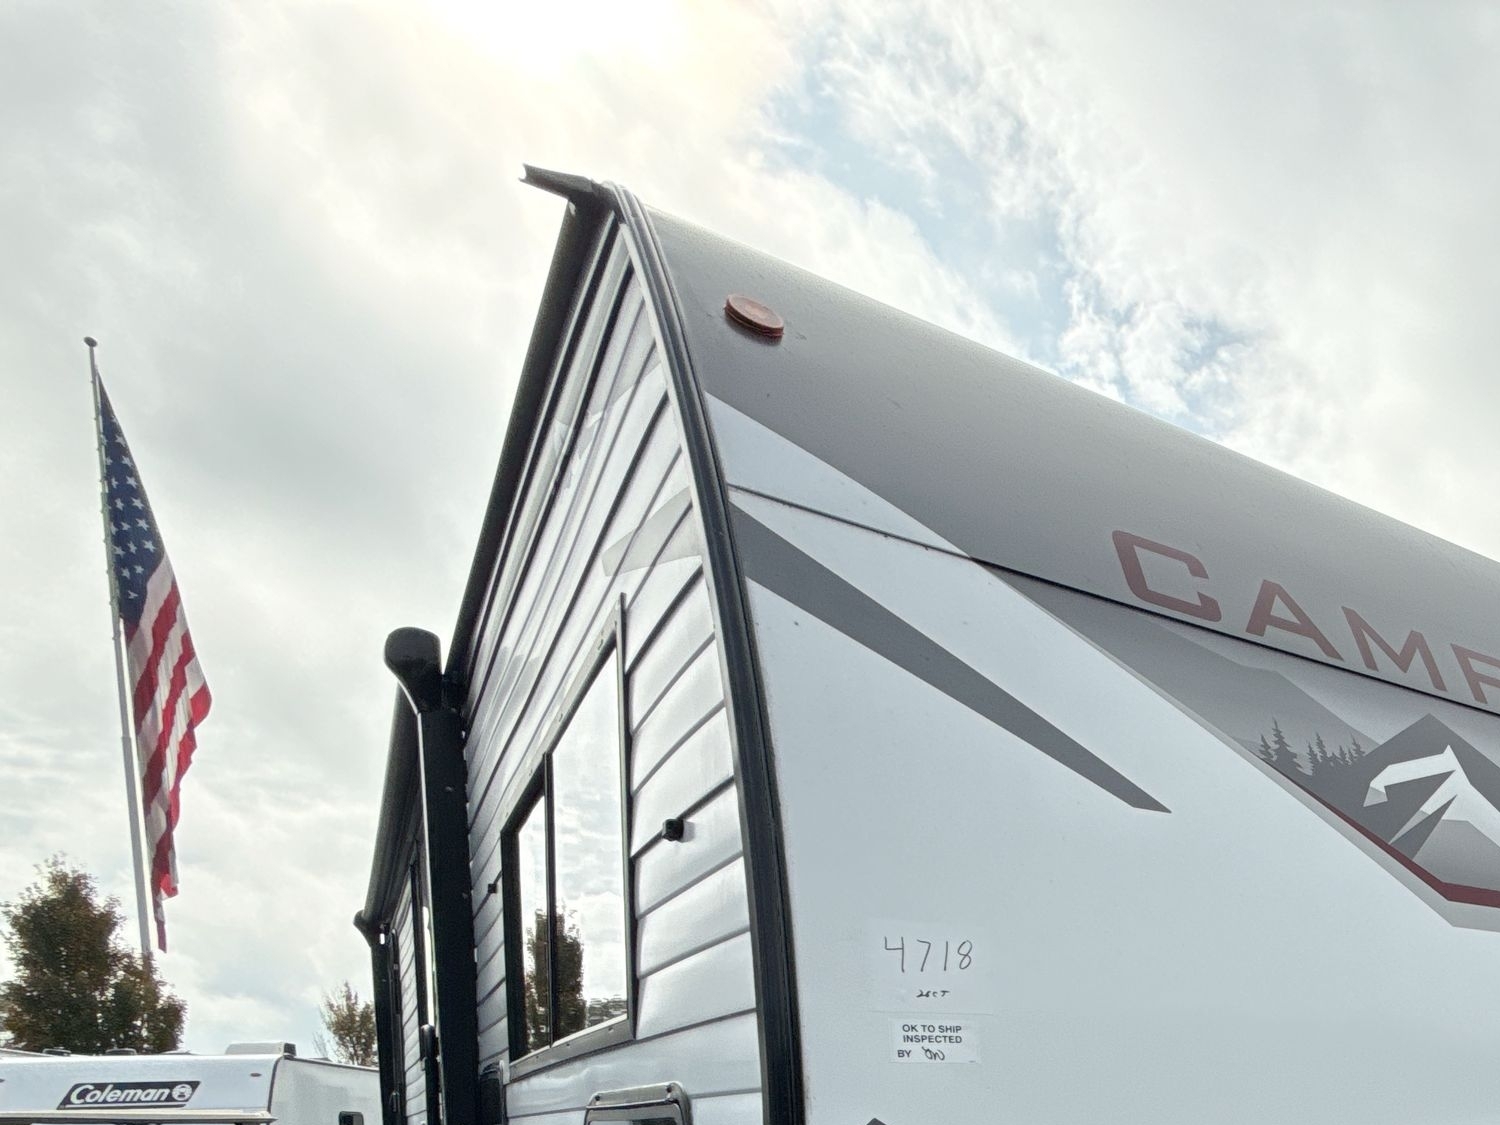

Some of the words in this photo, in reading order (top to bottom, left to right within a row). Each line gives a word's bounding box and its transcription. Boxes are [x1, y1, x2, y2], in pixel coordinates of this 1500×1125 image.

[884, 935, 973, 974] 4718
[902, 1023, 919, 1033] OK
[920, 1024, 936, 1034] TO
[938, 1025, 962, 1034] SHIP
[903, 1034, 963, 1044] INSPECTED
[897, 1049, 912, 1058] BY
[69, 1083, 171, 1105] Coleman
